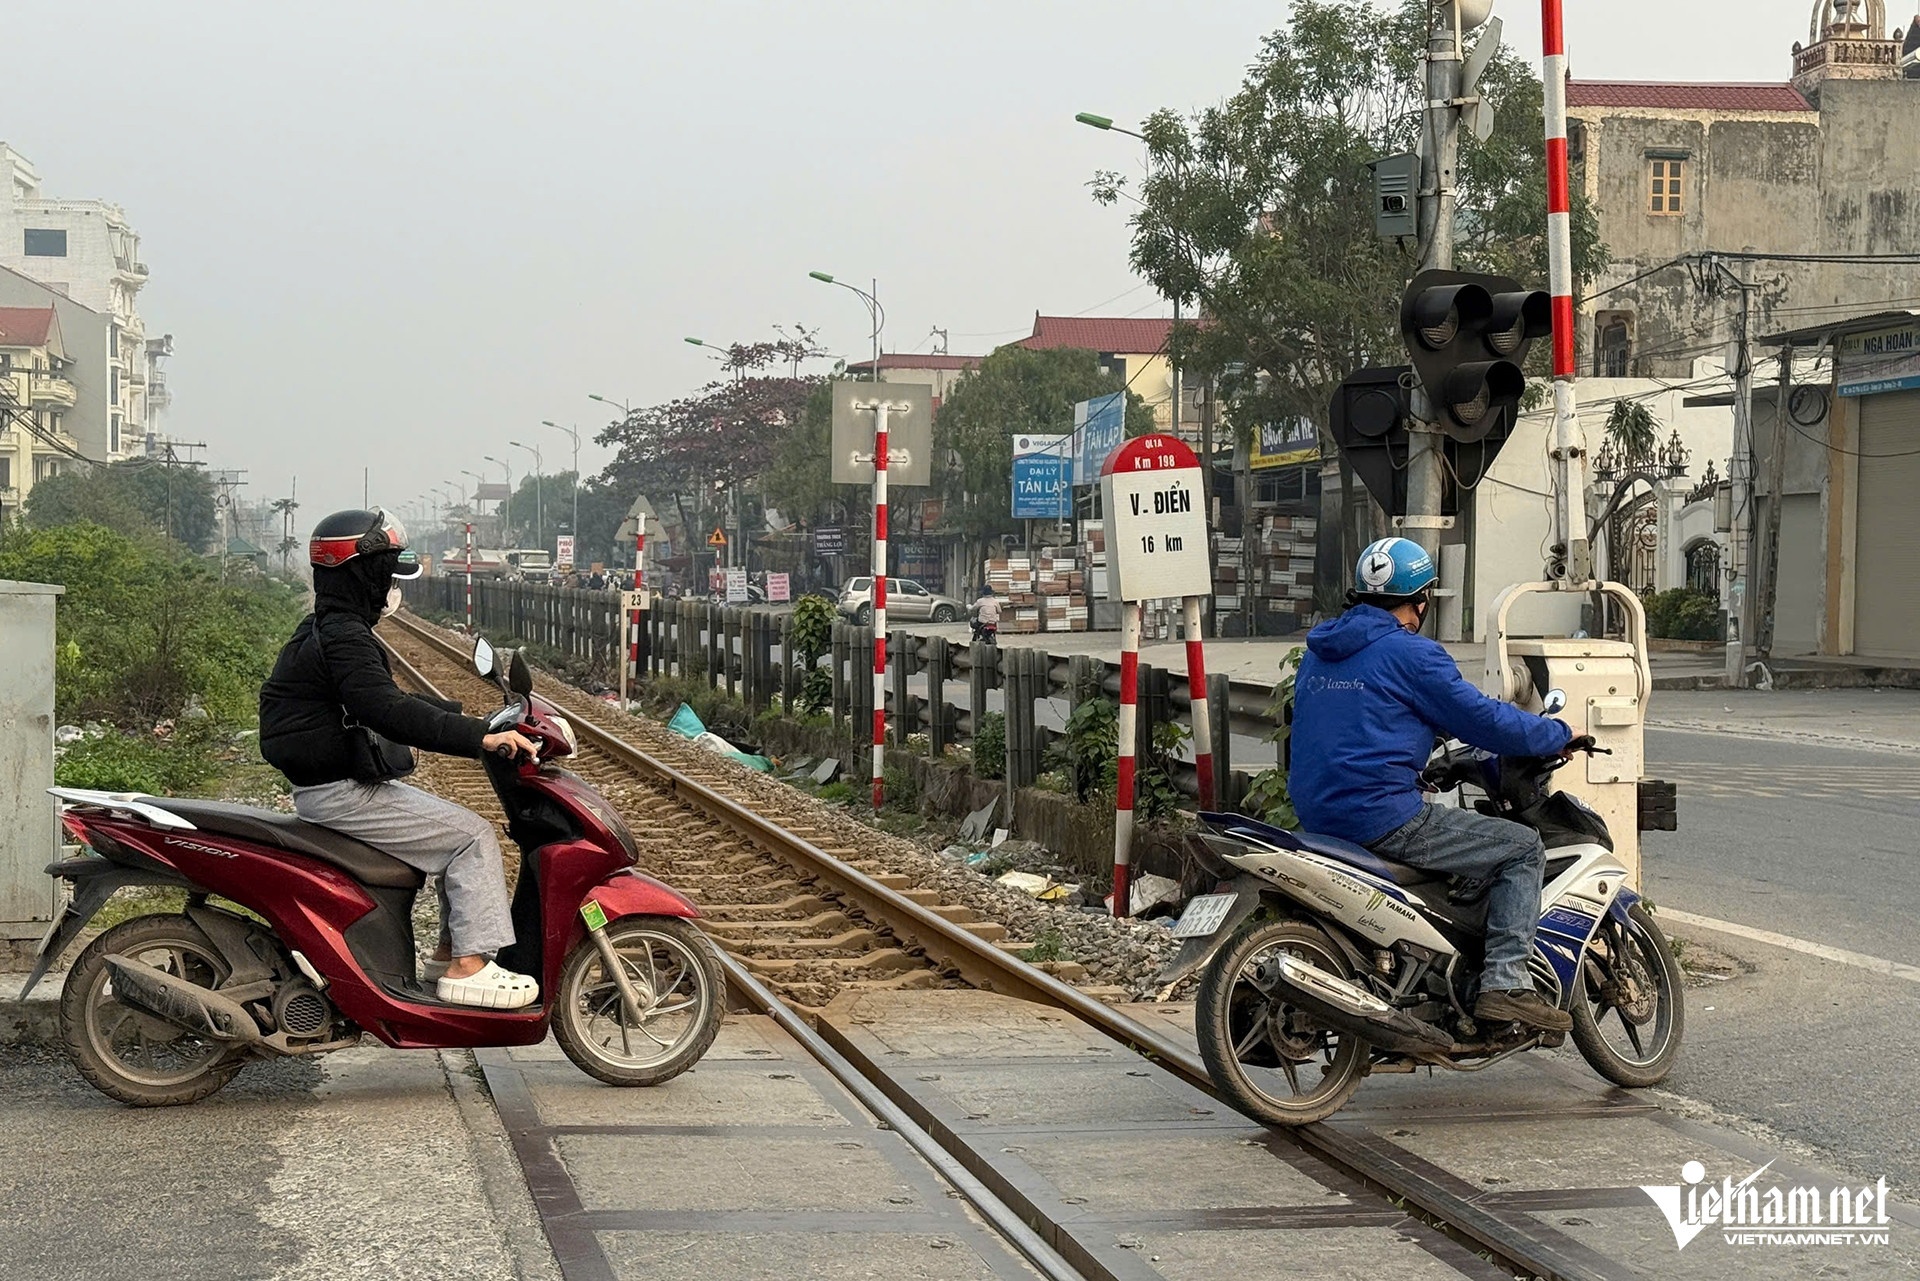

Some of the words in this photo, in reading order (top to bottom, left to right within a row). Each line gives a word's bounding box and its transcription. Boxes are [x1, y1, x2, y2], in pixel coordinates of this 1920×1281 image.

[1864, 335, 1883, 355] NGA
[1886, 330, 1912, 351] HOÀN
[1145, 438, 1163, 449] QL1A
[1134, 456, 1151, 469] Km
[1158, 454, 1175, 467] 198
[1029, 467, 1044, 477] ĐẠI
[1018, 477, 1042, 493] TÂN
[1154, 480, 1190, 514] ĐIỂN
[1141, 535, 1154, 553] 16
[1165, 534, 1182, 552] km
[631, 594, 641, 606] 23
[164, 837, 240, 859] VISION
[1386, 900, 1417, 922] YAMAHA
